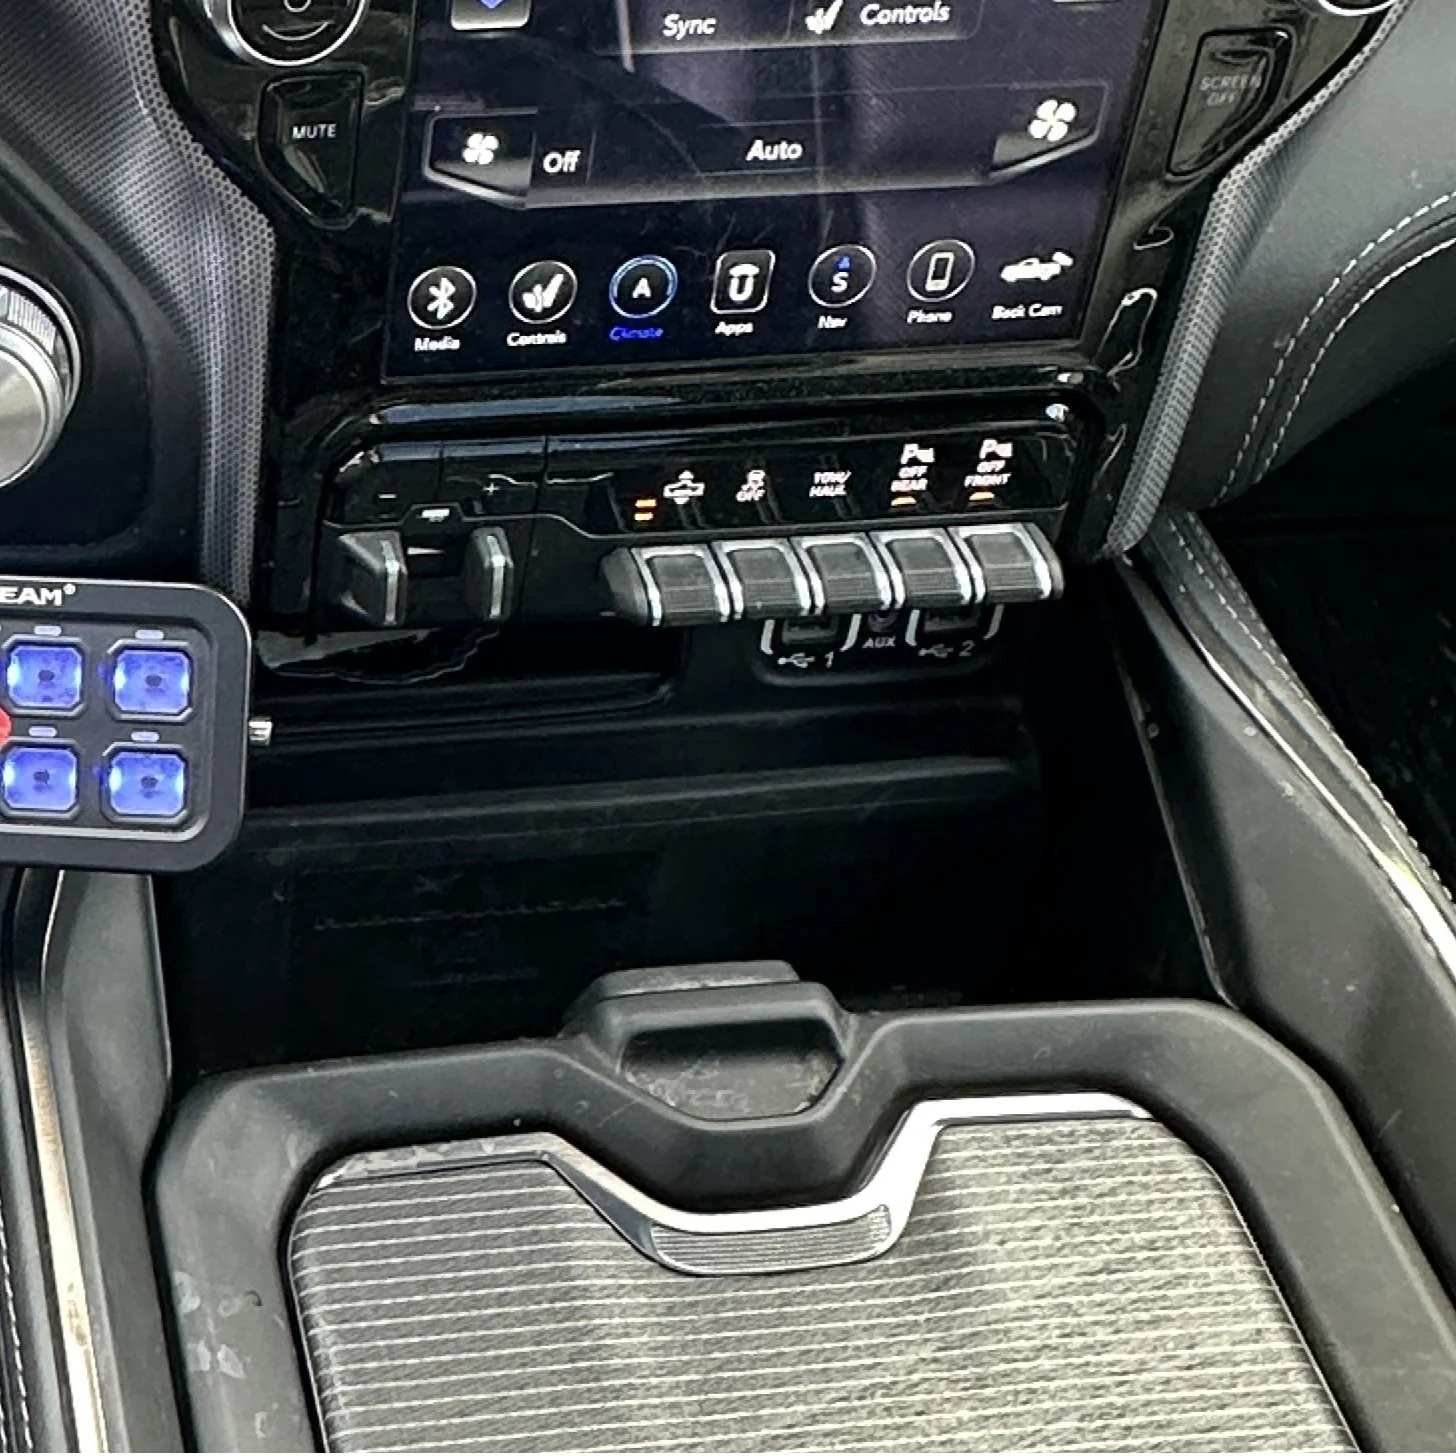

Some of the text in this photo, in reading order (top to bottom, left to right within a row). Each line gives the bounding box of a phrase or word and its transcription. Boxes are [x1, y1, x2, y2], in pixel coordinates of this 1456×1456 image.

[860, 2, 951, 27] Controls
[662, 14, 717, 39] Sync
[1199, 74, 1263, 92] SCREEN
[292, 123, 337, 140] MUTE
[746, 139, 803, 162] Auto
[543, 149, 581, 174] Off
[906, 309, 953, 324] Phone
[714, 321, 754, 338] Apps
[413, 336, 461, 352] Media
[506, 329, 568, 348] Controls
[964, 473, 1012, 488] FRONT
[862, 635, 897, 650] AUX
